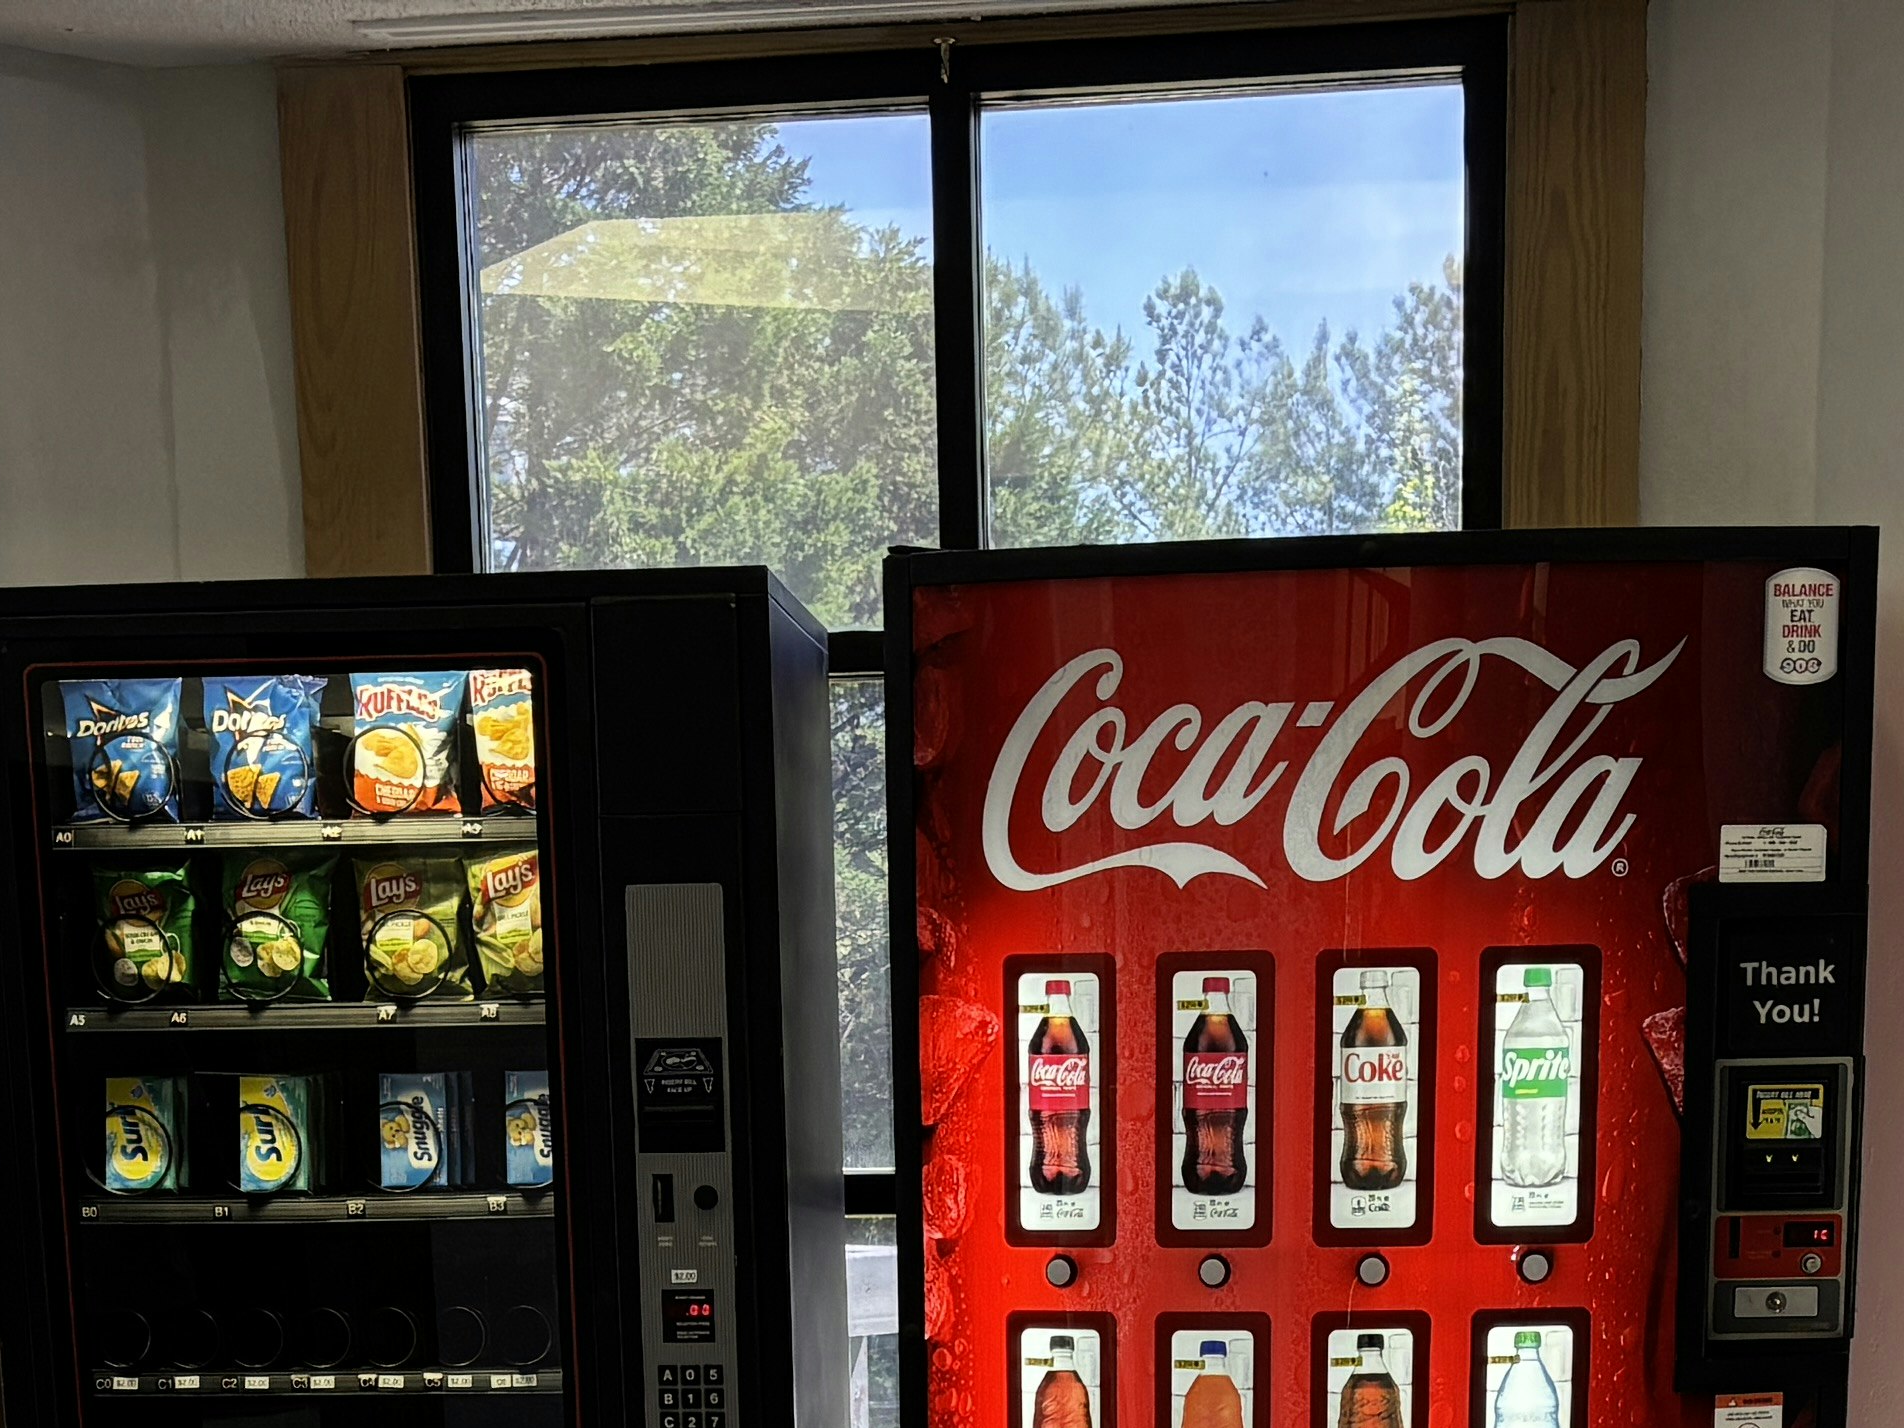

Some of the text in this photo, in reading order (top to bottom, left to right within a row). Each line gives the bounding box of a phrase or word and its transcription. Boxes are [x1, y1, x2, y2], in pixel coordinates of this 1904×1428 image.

[1774, 583, 1834, 597] BALANCE
[1808, 599, 1824, 608] YOU
[1790, 609, 1815, 623] EAT
[1782, 624, 1822, 638] DRINK
[1786, 640, 1815, 653] & DO
[77, 711, 149, 737] Doritos
[212, 710, 286, 733] Doros
[982, 635, 1688, 892] Coca-Cola
[56, 832, 72, 843] A0
[242, 873, 285, 897] Lay's
[487, 862, 534, 899] Lay's
[370, 874, 417, 906] Lay's
[115, 892, 158, 918] Lay's
[1739, 959, 1836, 986] Thank
[379, 1009, 393, 1020] A7
[1753, 998, 1820, 1024] You!
[70, 1014, 85, 1026] A5
[171, 1013, 187, 1024] A6
[1031, 1058, 1087, 1086] Coca-Cola
[1186, 1056, 1245, 1084] Coca-Cola
[1344, 1052, 1403, 1083] Coke
[1503, 1049, 1568, 1088] Sprite
[82, 1206, 97, 1218] B0
[214, 1206, 229, 1217] B1
[348, 1203, 363, 1214] B2
[489, 1200, 504, 1211] B3
[663, 1369, 718, 1381] A 0 5
[96, 1379, 112, 1389] C0
[158, 1378, 173, 1389] C1
[222, 1378, 238, 1389] C2
[664, 1393, 719, 1405] B 1 6
[664, 1417, 719, 1428] C 2 7
